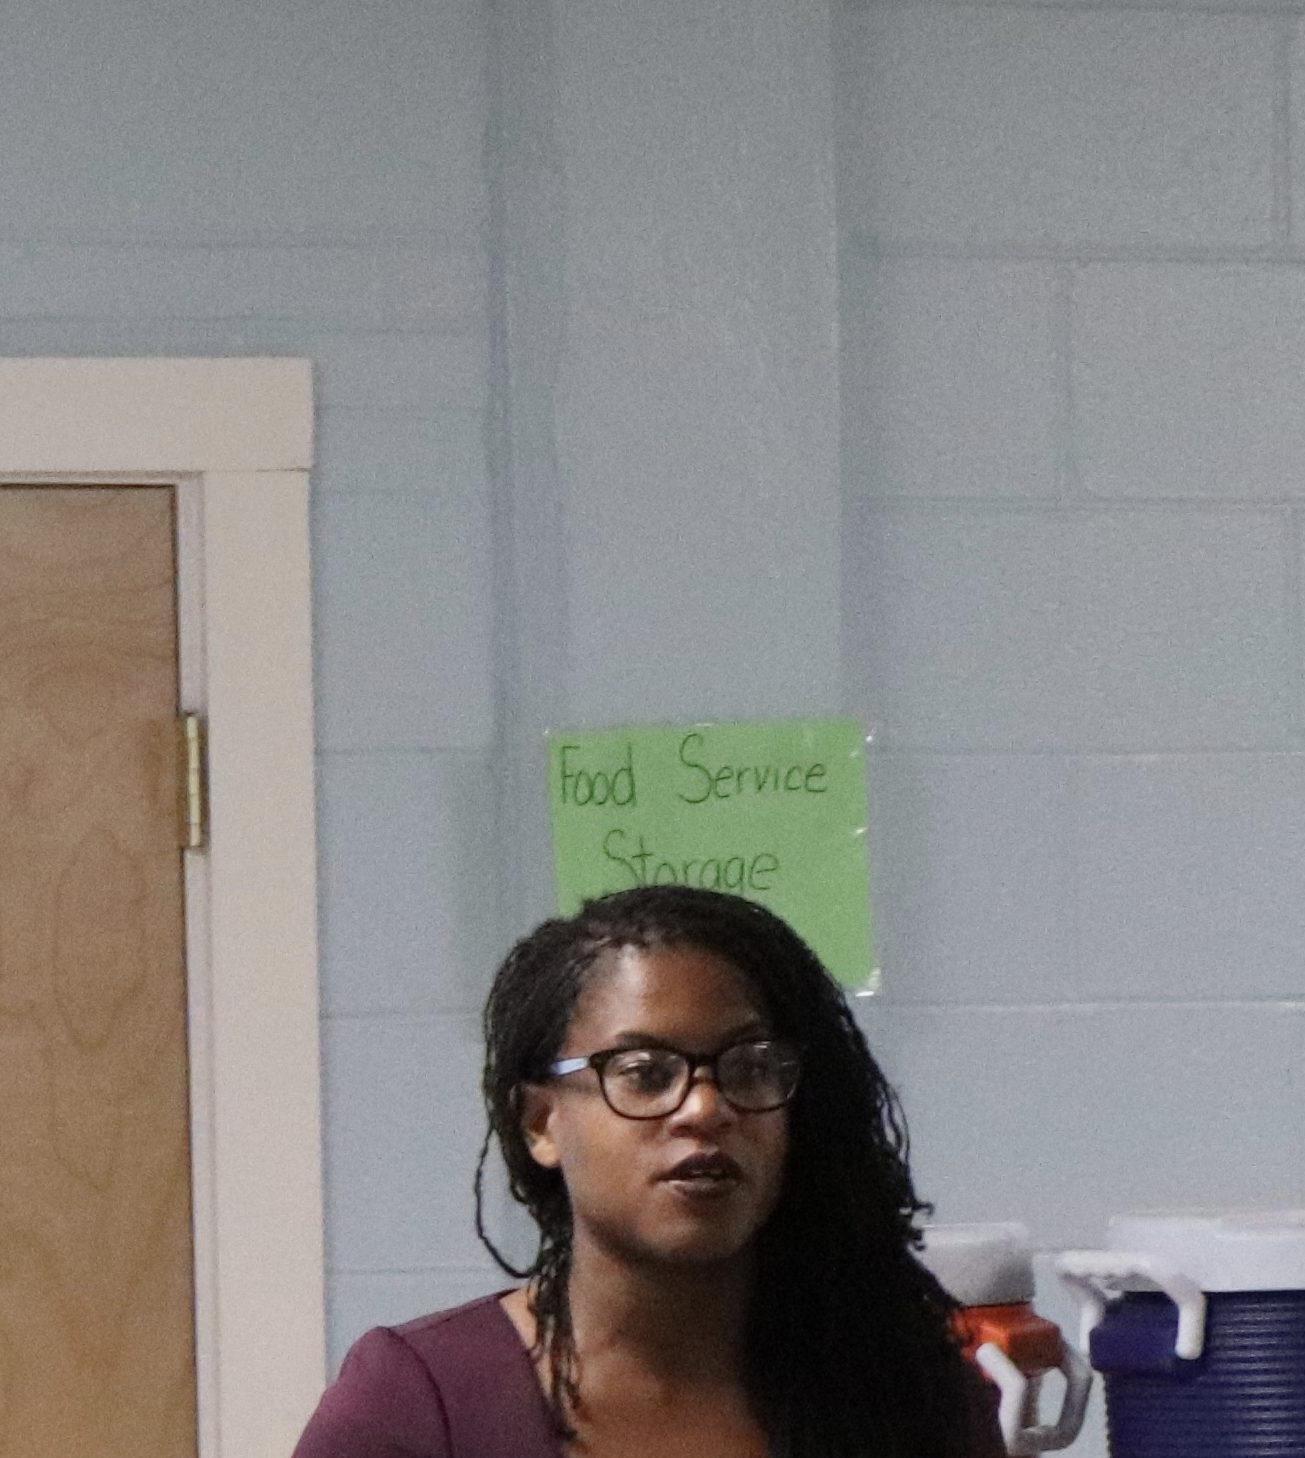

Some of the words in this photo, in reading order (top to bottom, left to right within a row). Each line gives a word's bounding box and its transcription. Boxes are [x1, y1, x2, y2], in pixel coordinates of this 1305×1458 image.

[559, 743, 636, 806] Food
[678, 733, 827, 804] Service
[603, 829, 779, 892] Storage
